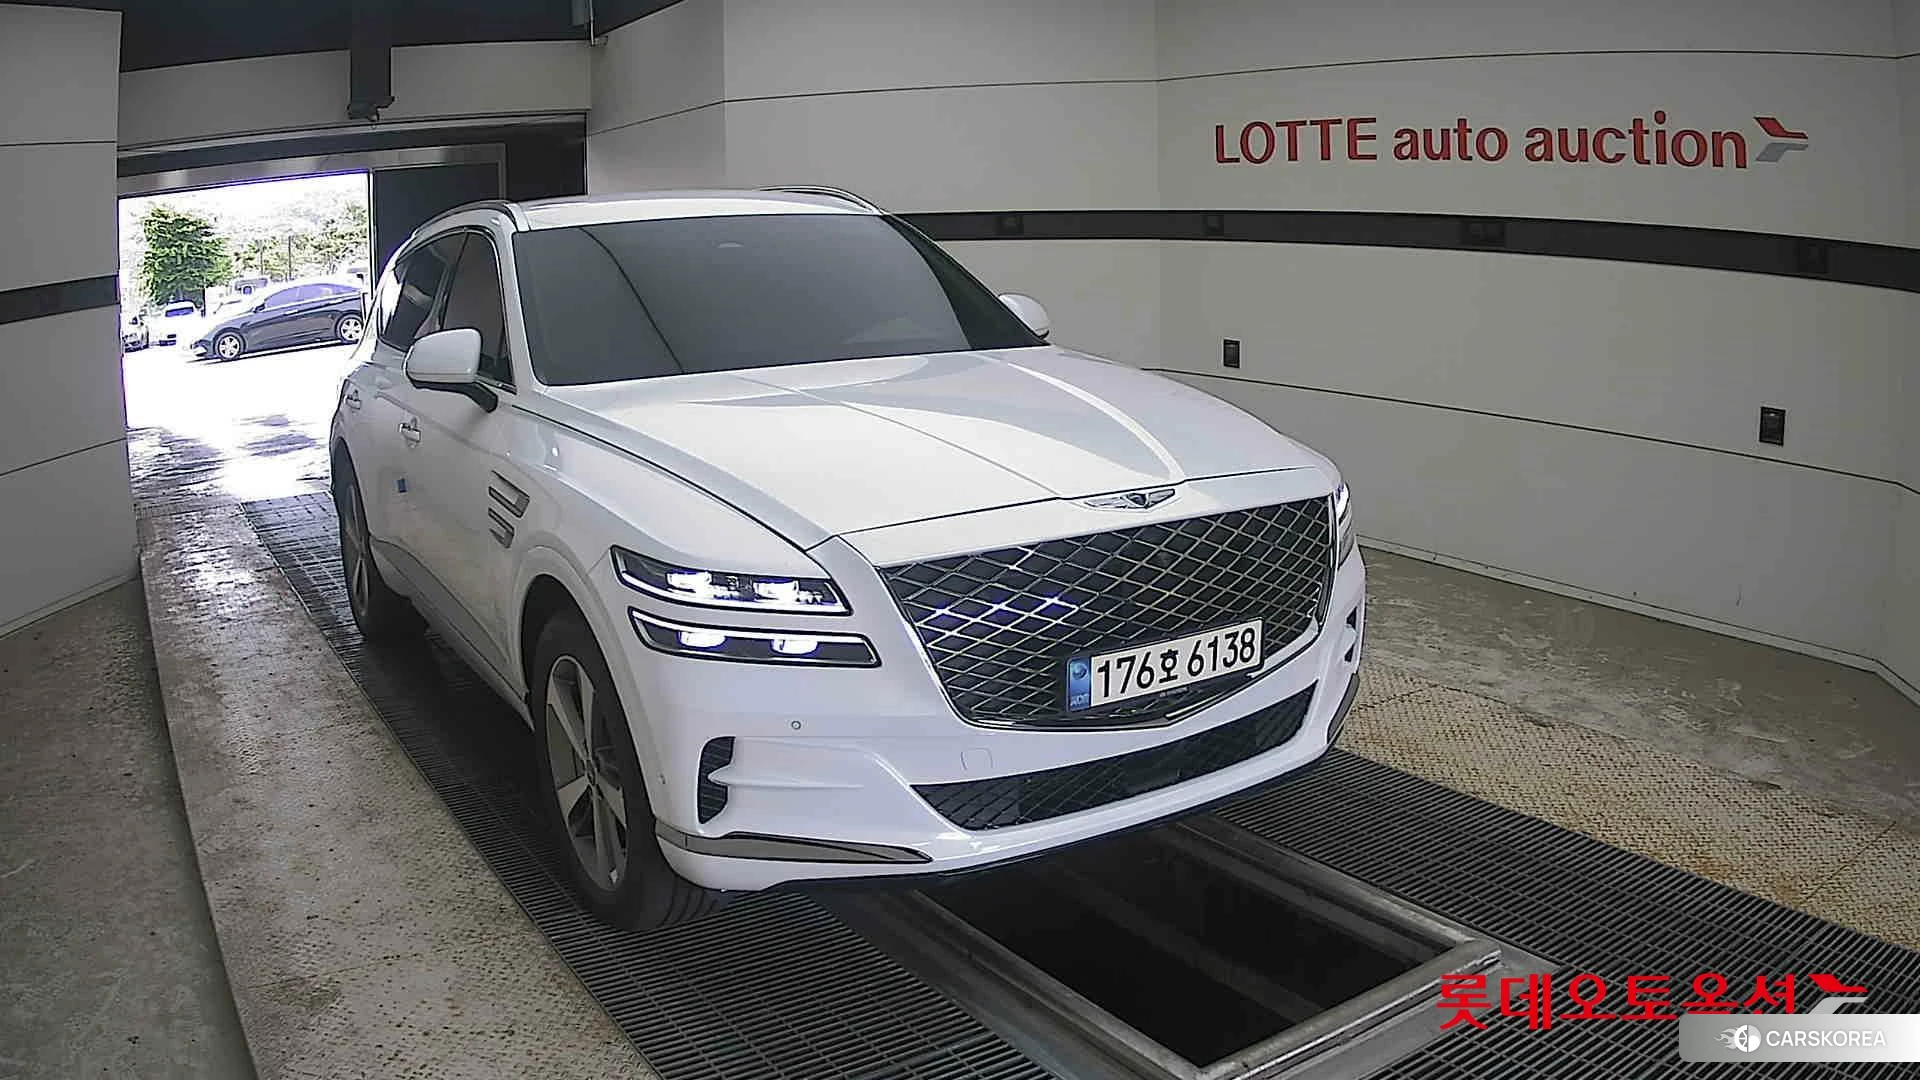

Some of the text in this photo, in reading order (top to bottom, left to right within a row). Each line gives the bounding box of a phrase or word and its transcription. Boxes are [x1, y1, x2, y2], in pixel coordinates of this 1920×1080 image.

[1216, 111, 1748, 168] LOTTE auto auction
[1097, 628, 1256, 697] 176호 6138
